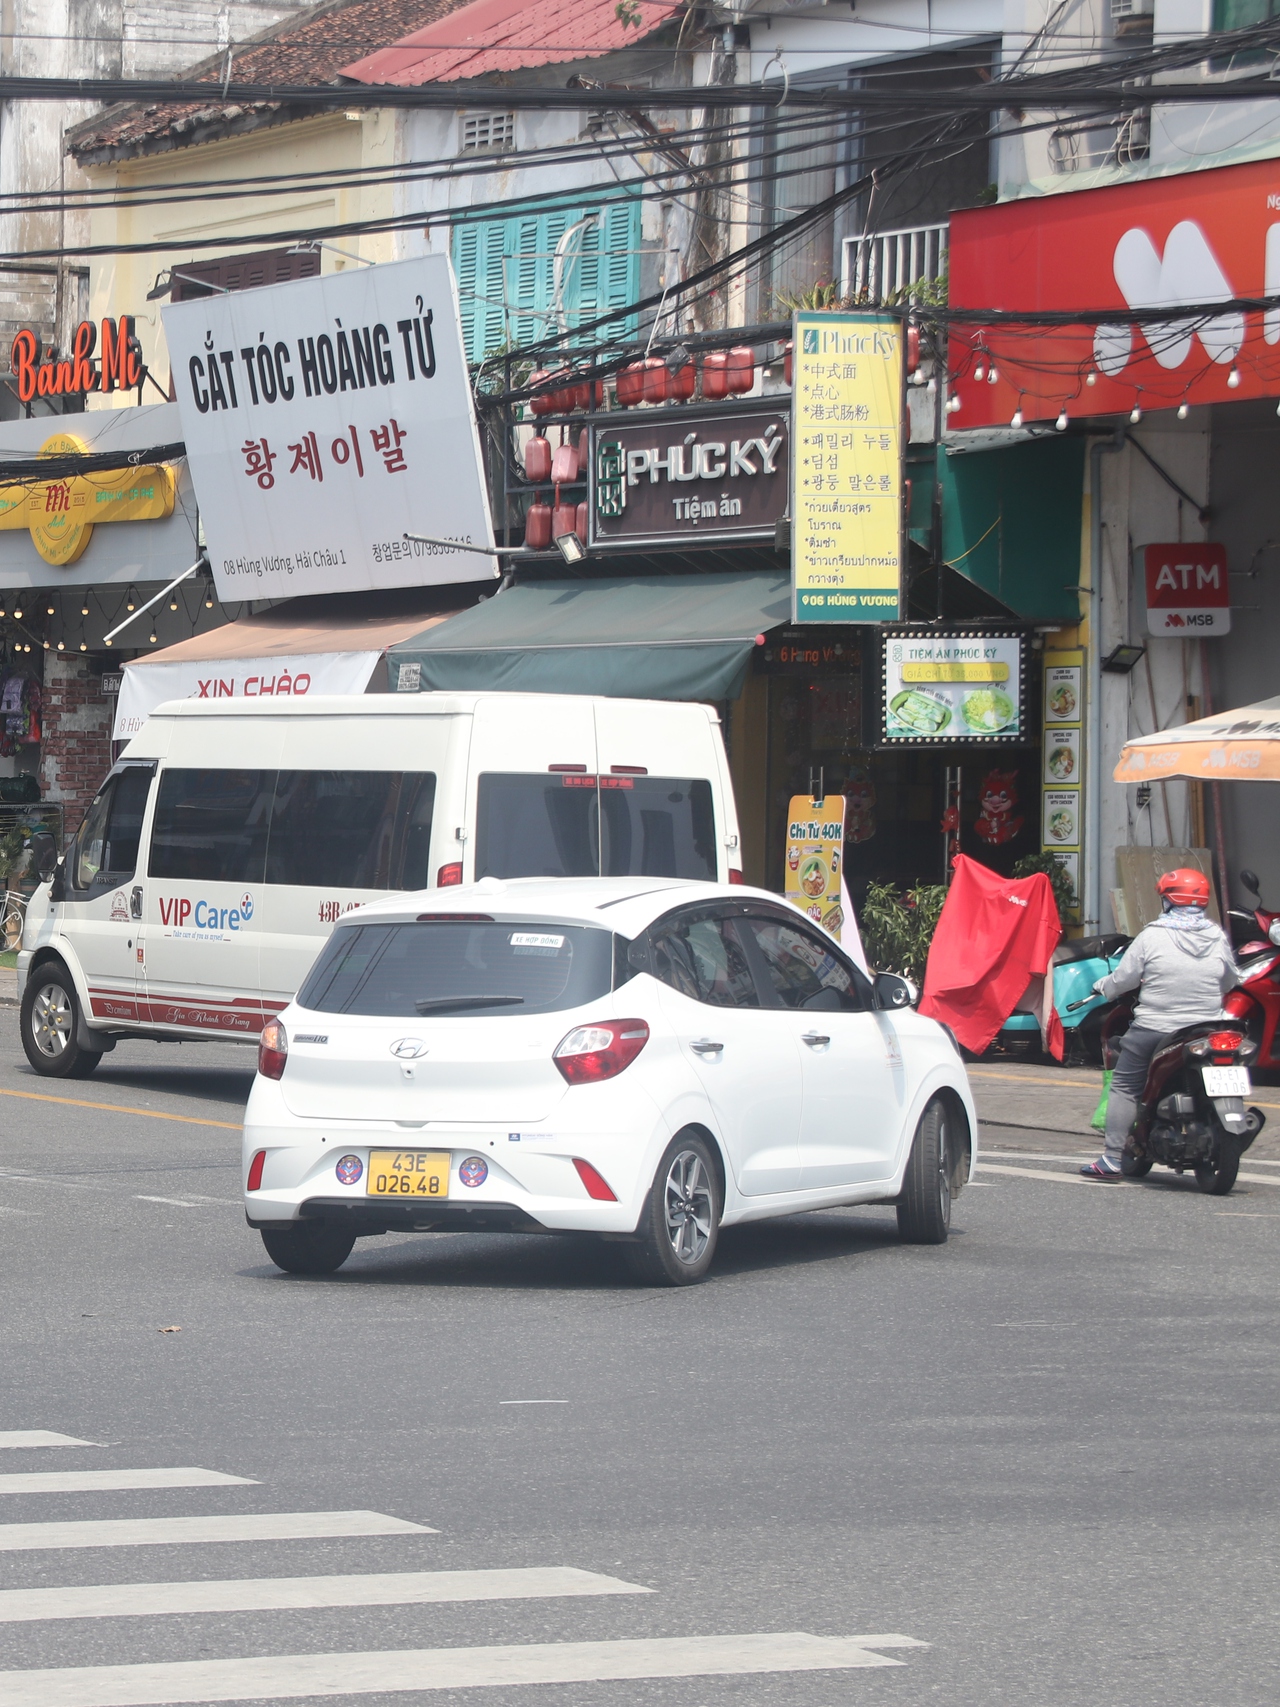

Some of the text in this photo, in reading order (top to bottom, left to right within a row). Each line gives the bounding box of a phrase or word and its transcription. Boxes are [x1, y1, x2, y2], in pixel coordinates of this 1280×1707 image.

[1266, 195, 1280, 210] Ng
[11, 315, 141, 402] Bánh Mì
[189, 294, 436, 414] CẮT TÓC HOÀNG TỬ
[863, 433, 892, 450] 누들
[627, 424, 784, 487] PHÚC KÝ
[672, 493, 742, 525] Tiệm ăn
[372, 541, 411, 563] 창업문의
[224, 548, 346, 577] 08 Hùng Hải Châu 1
[1154, 564, 1220, 590] ATM
[810, 593, 898, 606] 06 HÙNG VƯƠNG
[1187, 614, 1213, 626] MSB
[909, 649, 933, 660] TIỆM
[954, 647, 980, 659] PHÚC
[983, 647, 997, 659] KÝ
[197, 668, 311, 697] XIN CHÀO
[120, 717, 126, 733] 8
[1148, 752, 1180, 768] MSB
[1229, 750, 1261, 768] MSB
[790, 820, 842, 839] Chỉ Từ 40K
[159, 897, 191, 927] VIP
[194, 900, 240, 931] Care
[524, 937, 539, 945] HỢP
[392, 1154, 427, 1172] 43E
[376, 1175, 440, 1194] 026.48
